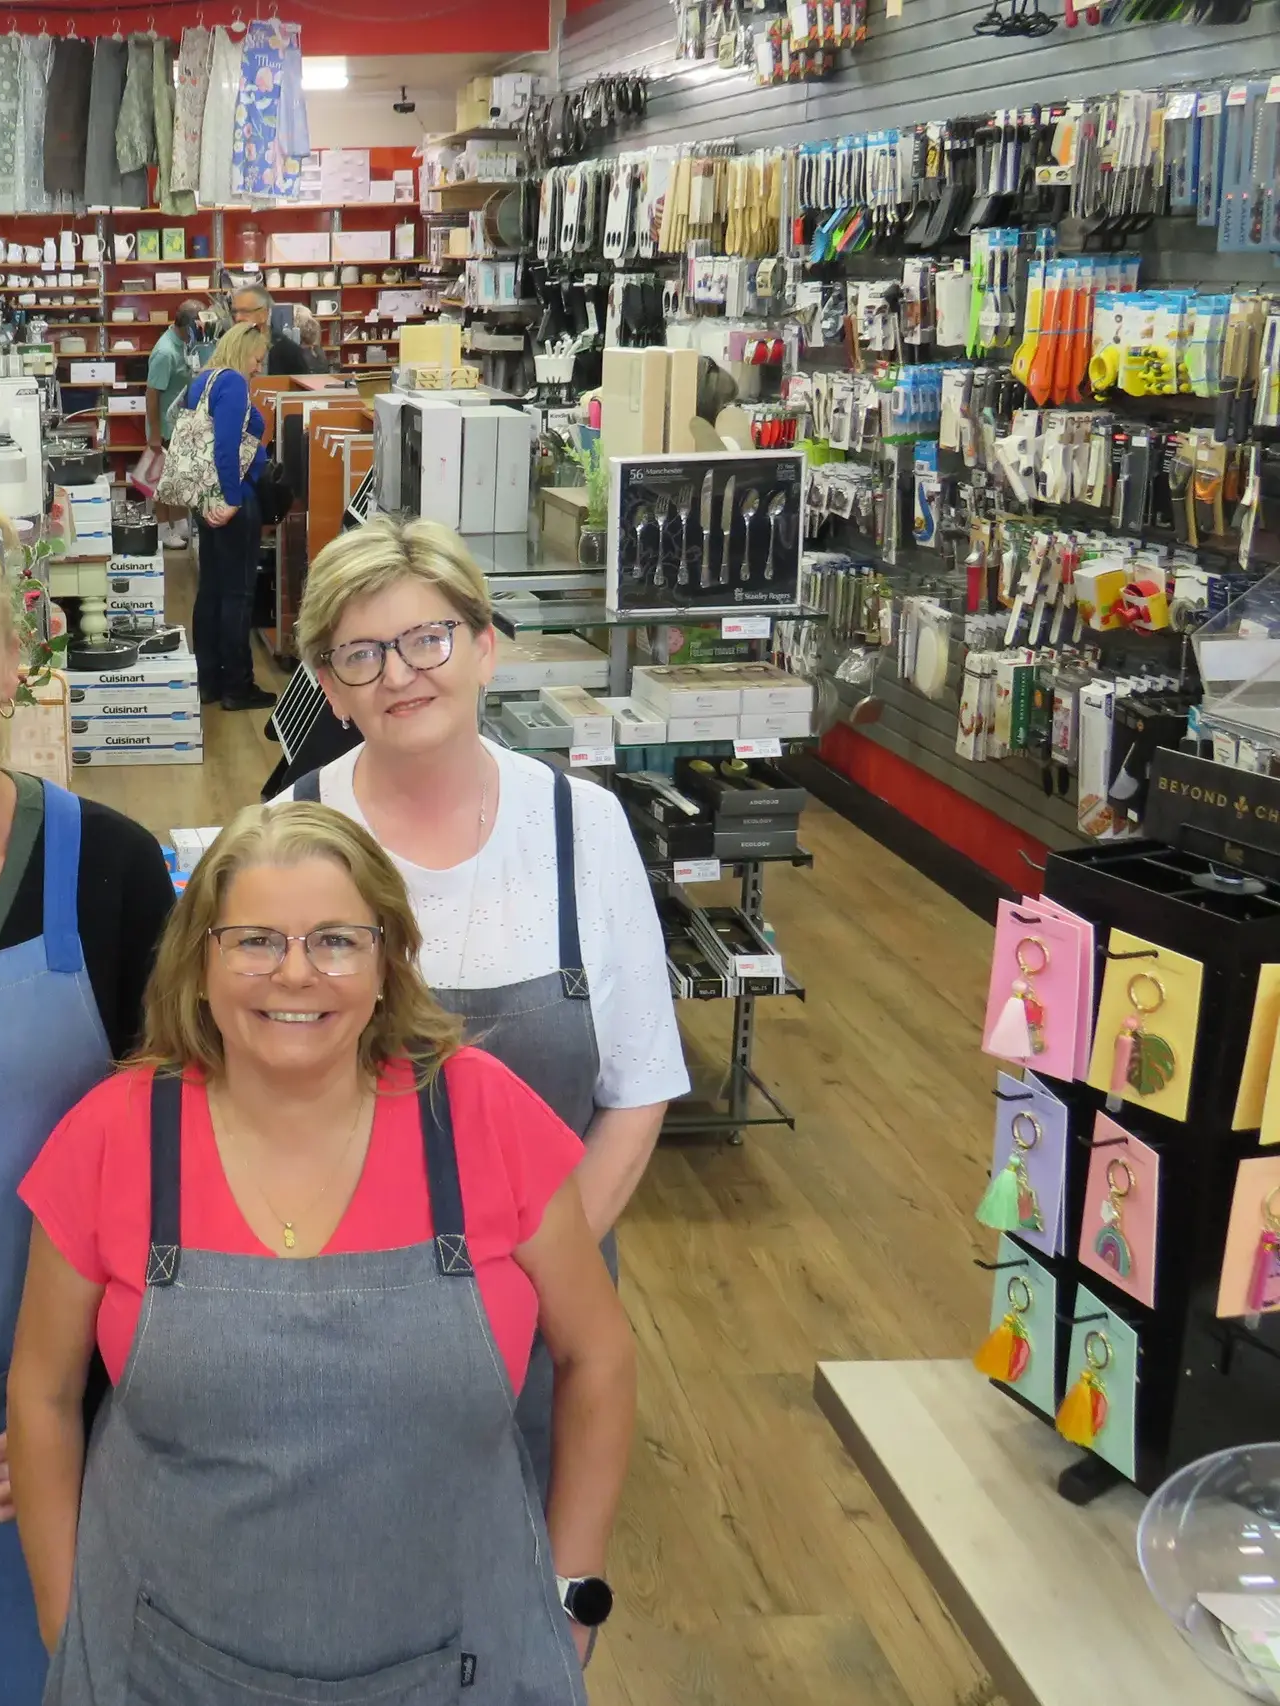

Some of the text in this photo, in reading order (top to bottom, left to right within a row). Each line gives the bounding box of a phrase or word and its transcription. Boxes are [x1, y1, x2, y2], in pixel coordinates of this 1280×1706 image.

[629, 468, 644, 480] 56
[110, 562, 153, 571] Cuisinart
[744, 592, 791, 602] Stanley Rogers
[99, 674, 145, 683] Cuisinart
[102, 705, 148, 714] Cuisinart
[105, 736, 151, 745] Cuisinart
[1158, 776, 1228, 808] BEYOND
[740, 840, 771, 848] ECOLOGY
